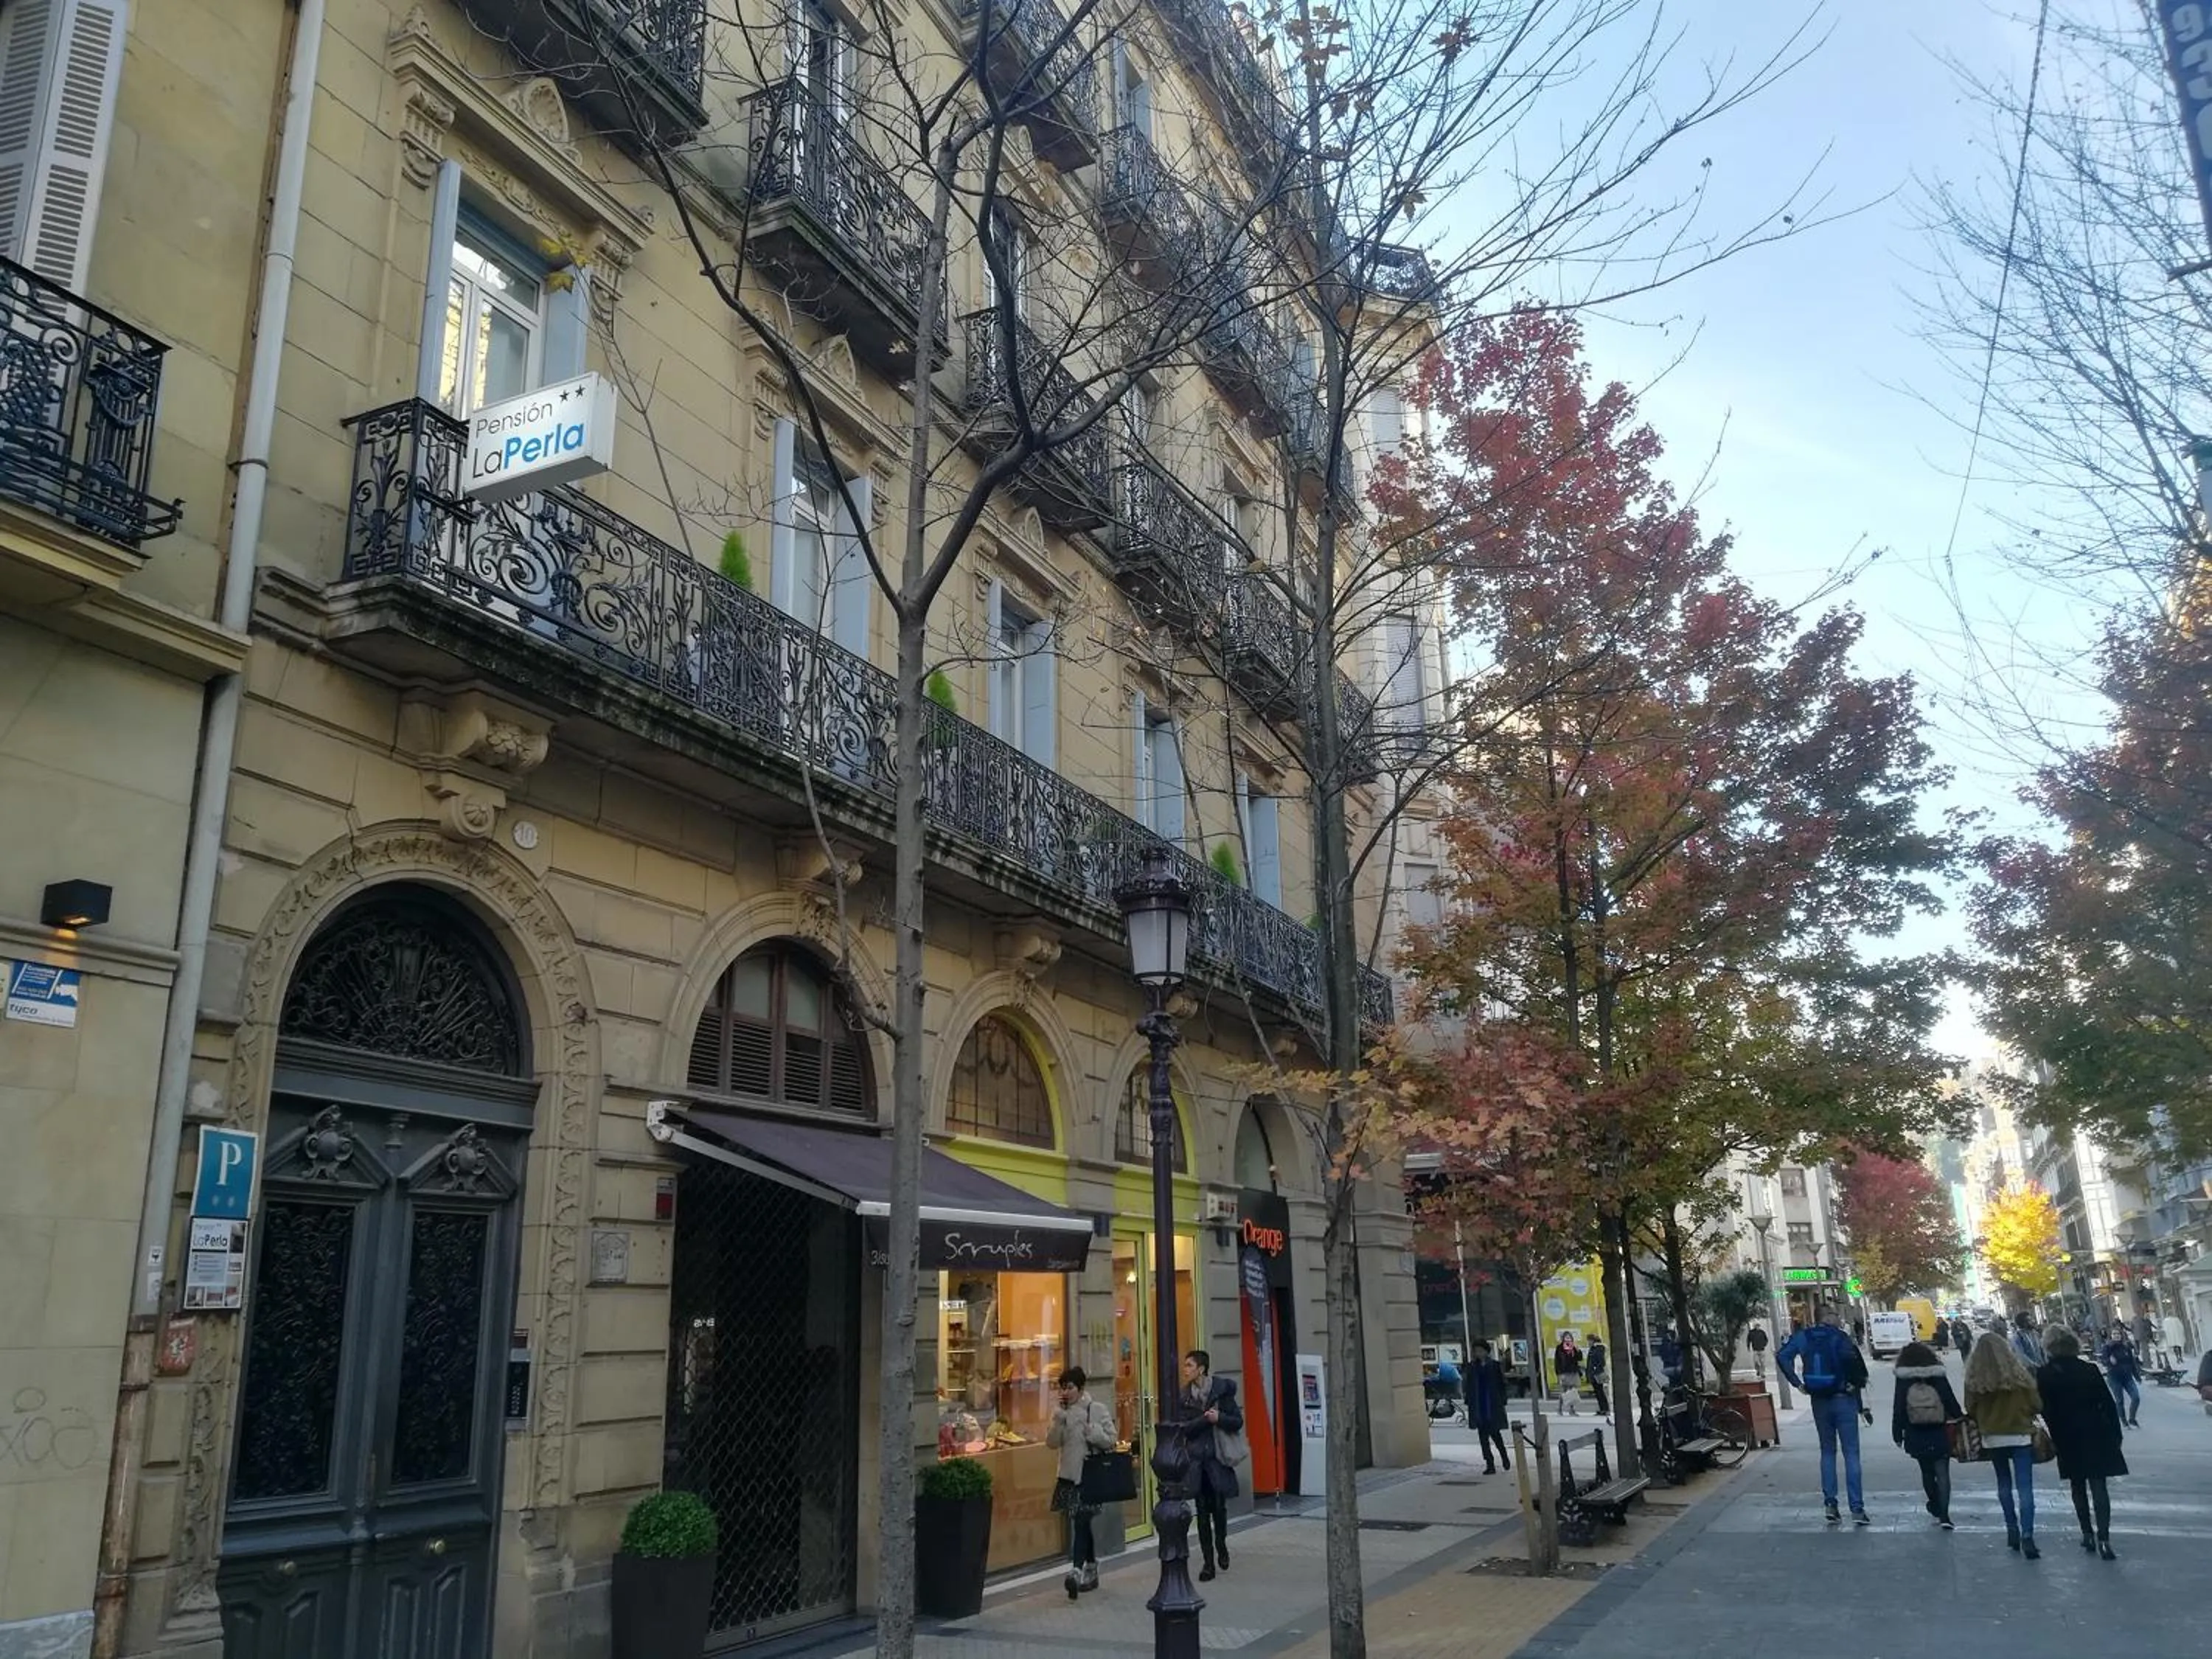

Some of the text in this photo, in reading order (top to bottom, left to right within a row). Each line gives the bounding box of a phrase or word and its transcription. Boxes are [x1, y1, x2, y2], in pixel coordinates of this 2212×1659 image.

[476, 402, 553, 439] Pensión
[10, 1004, 38, 1015] tyco
[215, 1141, 242, 1186] P
[1243, 1219, 1283, 1257] Orange
